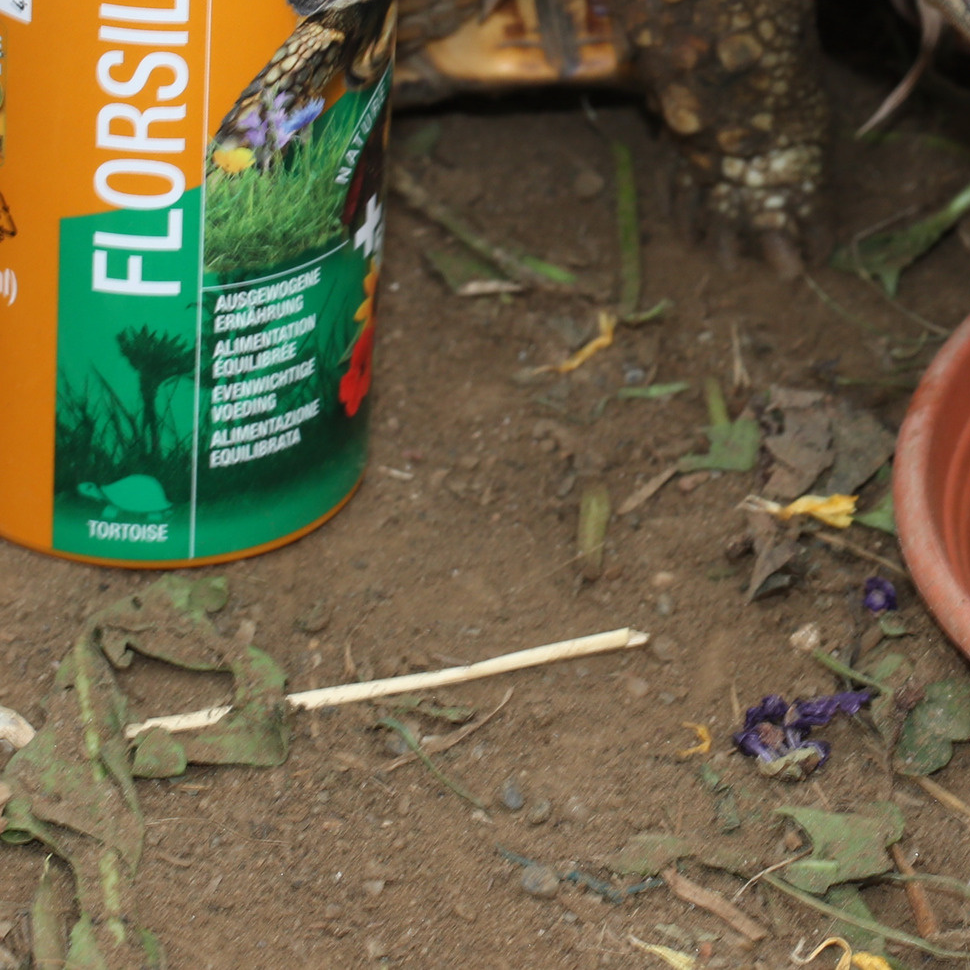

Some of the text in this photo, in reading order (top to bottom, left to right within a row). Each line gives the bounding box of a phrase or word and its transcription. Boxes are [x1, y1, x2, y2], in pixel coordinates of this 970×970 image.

[335, 86, 386, 184] NATURE
[214, 267, 321, 314] AUSGEWOGENE
[214, 295, 304, 333] ERNÄHRUNG
[212, 313, 317, 359] ALIMENTATION
[211, 357, 316, 404] EVENWICHTIGE
[212, 341, 298, 379] ÉQUILIBRÉE
[209, 398, 320, 449] ALIMENTAZIONE
[210, 393, 277, 423] VOEDING
[209, 428, 301, 469] EQUILIBRATA
[87, 519, 169, 542] TORTOISE
